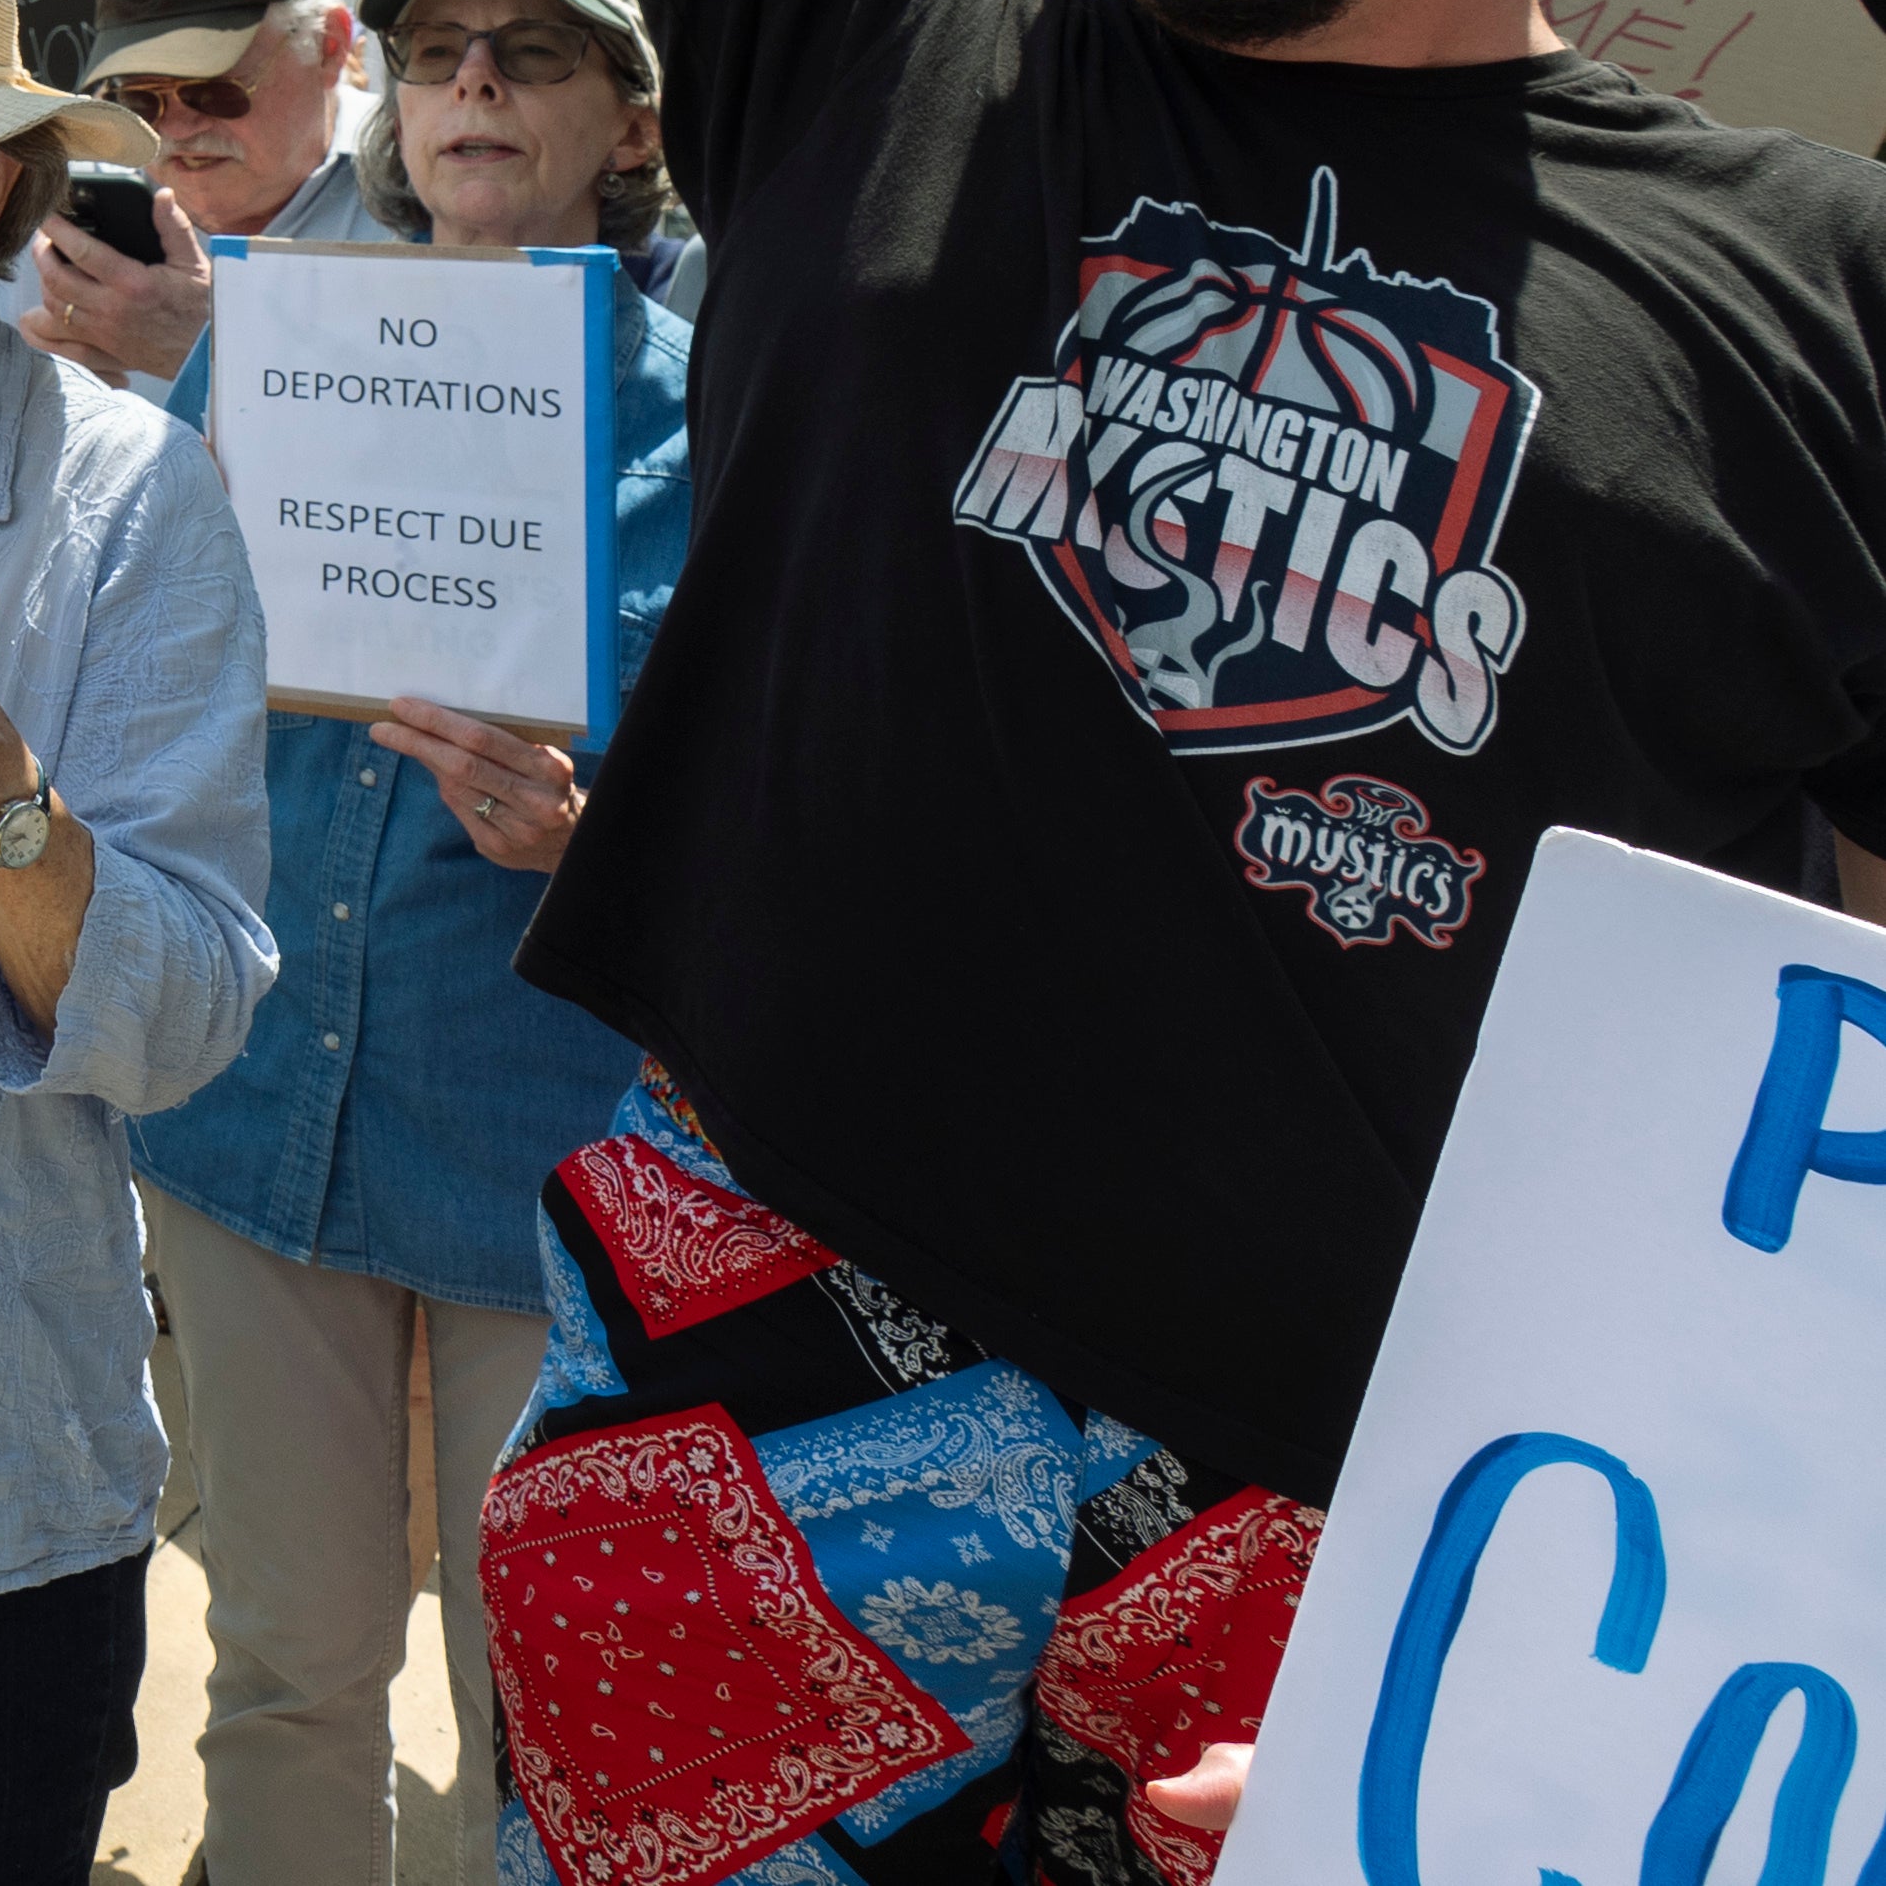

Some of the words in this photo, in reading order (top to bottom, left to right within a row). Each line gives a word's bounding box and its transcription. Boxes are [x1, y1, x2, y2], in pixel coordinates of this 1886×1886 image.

[379, 316, 440, 349] NO
[262, 368, 563, 419] DEPORTATIONS
[1085, 354, 1411, 513] WASHINGTON
[278, 497, 445, 543] RESPECT
[458, 514, 545, 552] DUE
[321, 562, 499, 610] PROCESS
[958, 384, 1513, 745] MYSTICS
[1261, 812, 1453, 917] mystics
